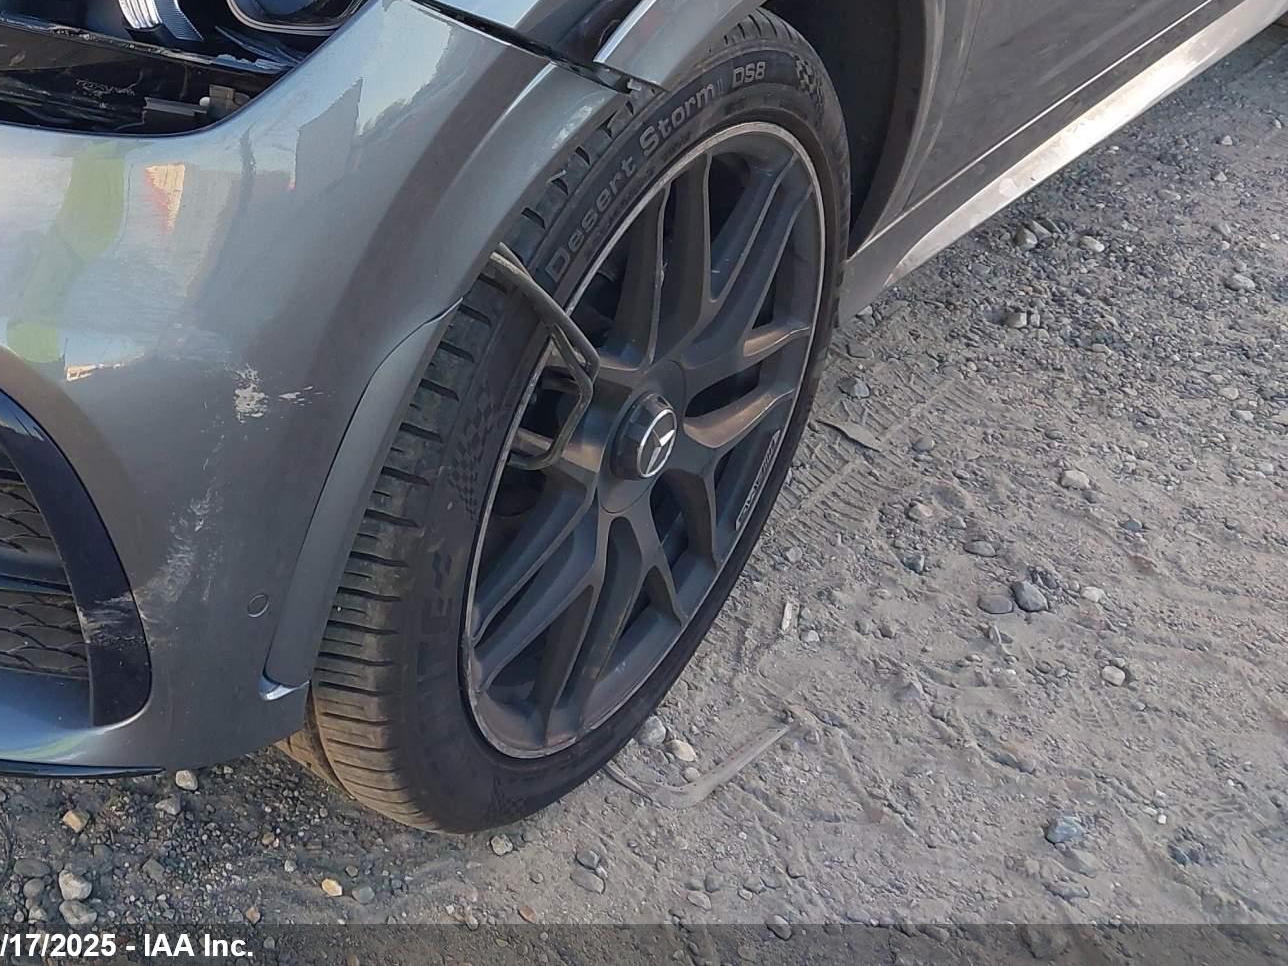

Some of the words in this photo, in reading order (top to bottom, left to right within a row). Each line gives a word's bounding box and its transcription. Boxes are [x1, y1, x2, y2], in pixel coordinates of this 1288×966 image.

[544, 154, 637, 283] Desert
[639, 82, 714, 157] Storm
[731, 61, 766, 88] DS8
